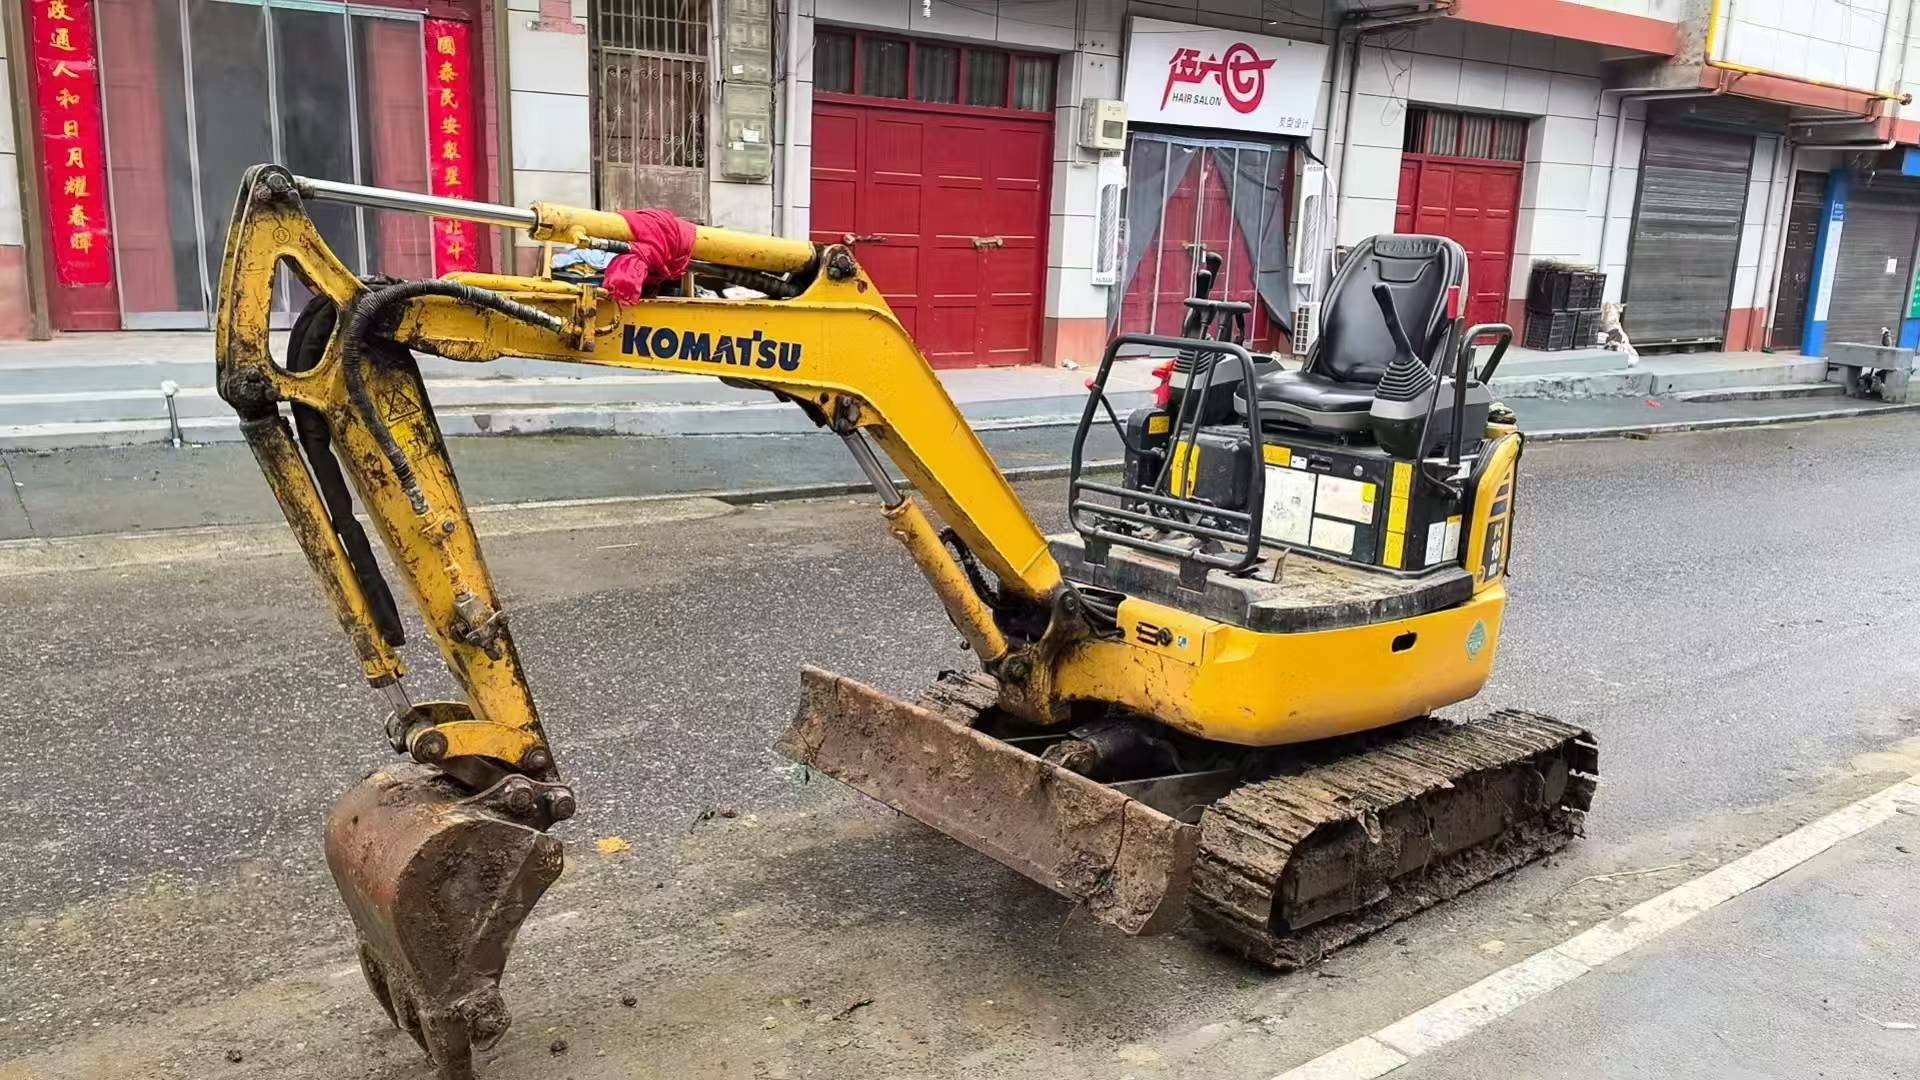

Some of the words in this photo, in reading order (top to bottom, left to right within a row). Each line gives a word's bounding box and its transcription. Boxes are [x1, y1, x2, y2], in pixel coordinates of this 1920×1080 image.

[1172, 92, 1193, 103] HAIR
[1193, 94, 1222, 106] SALON
[437, 35, 464, 260] 國泰民安星北斗
[622, 324, 802, 371] KOMATSU
